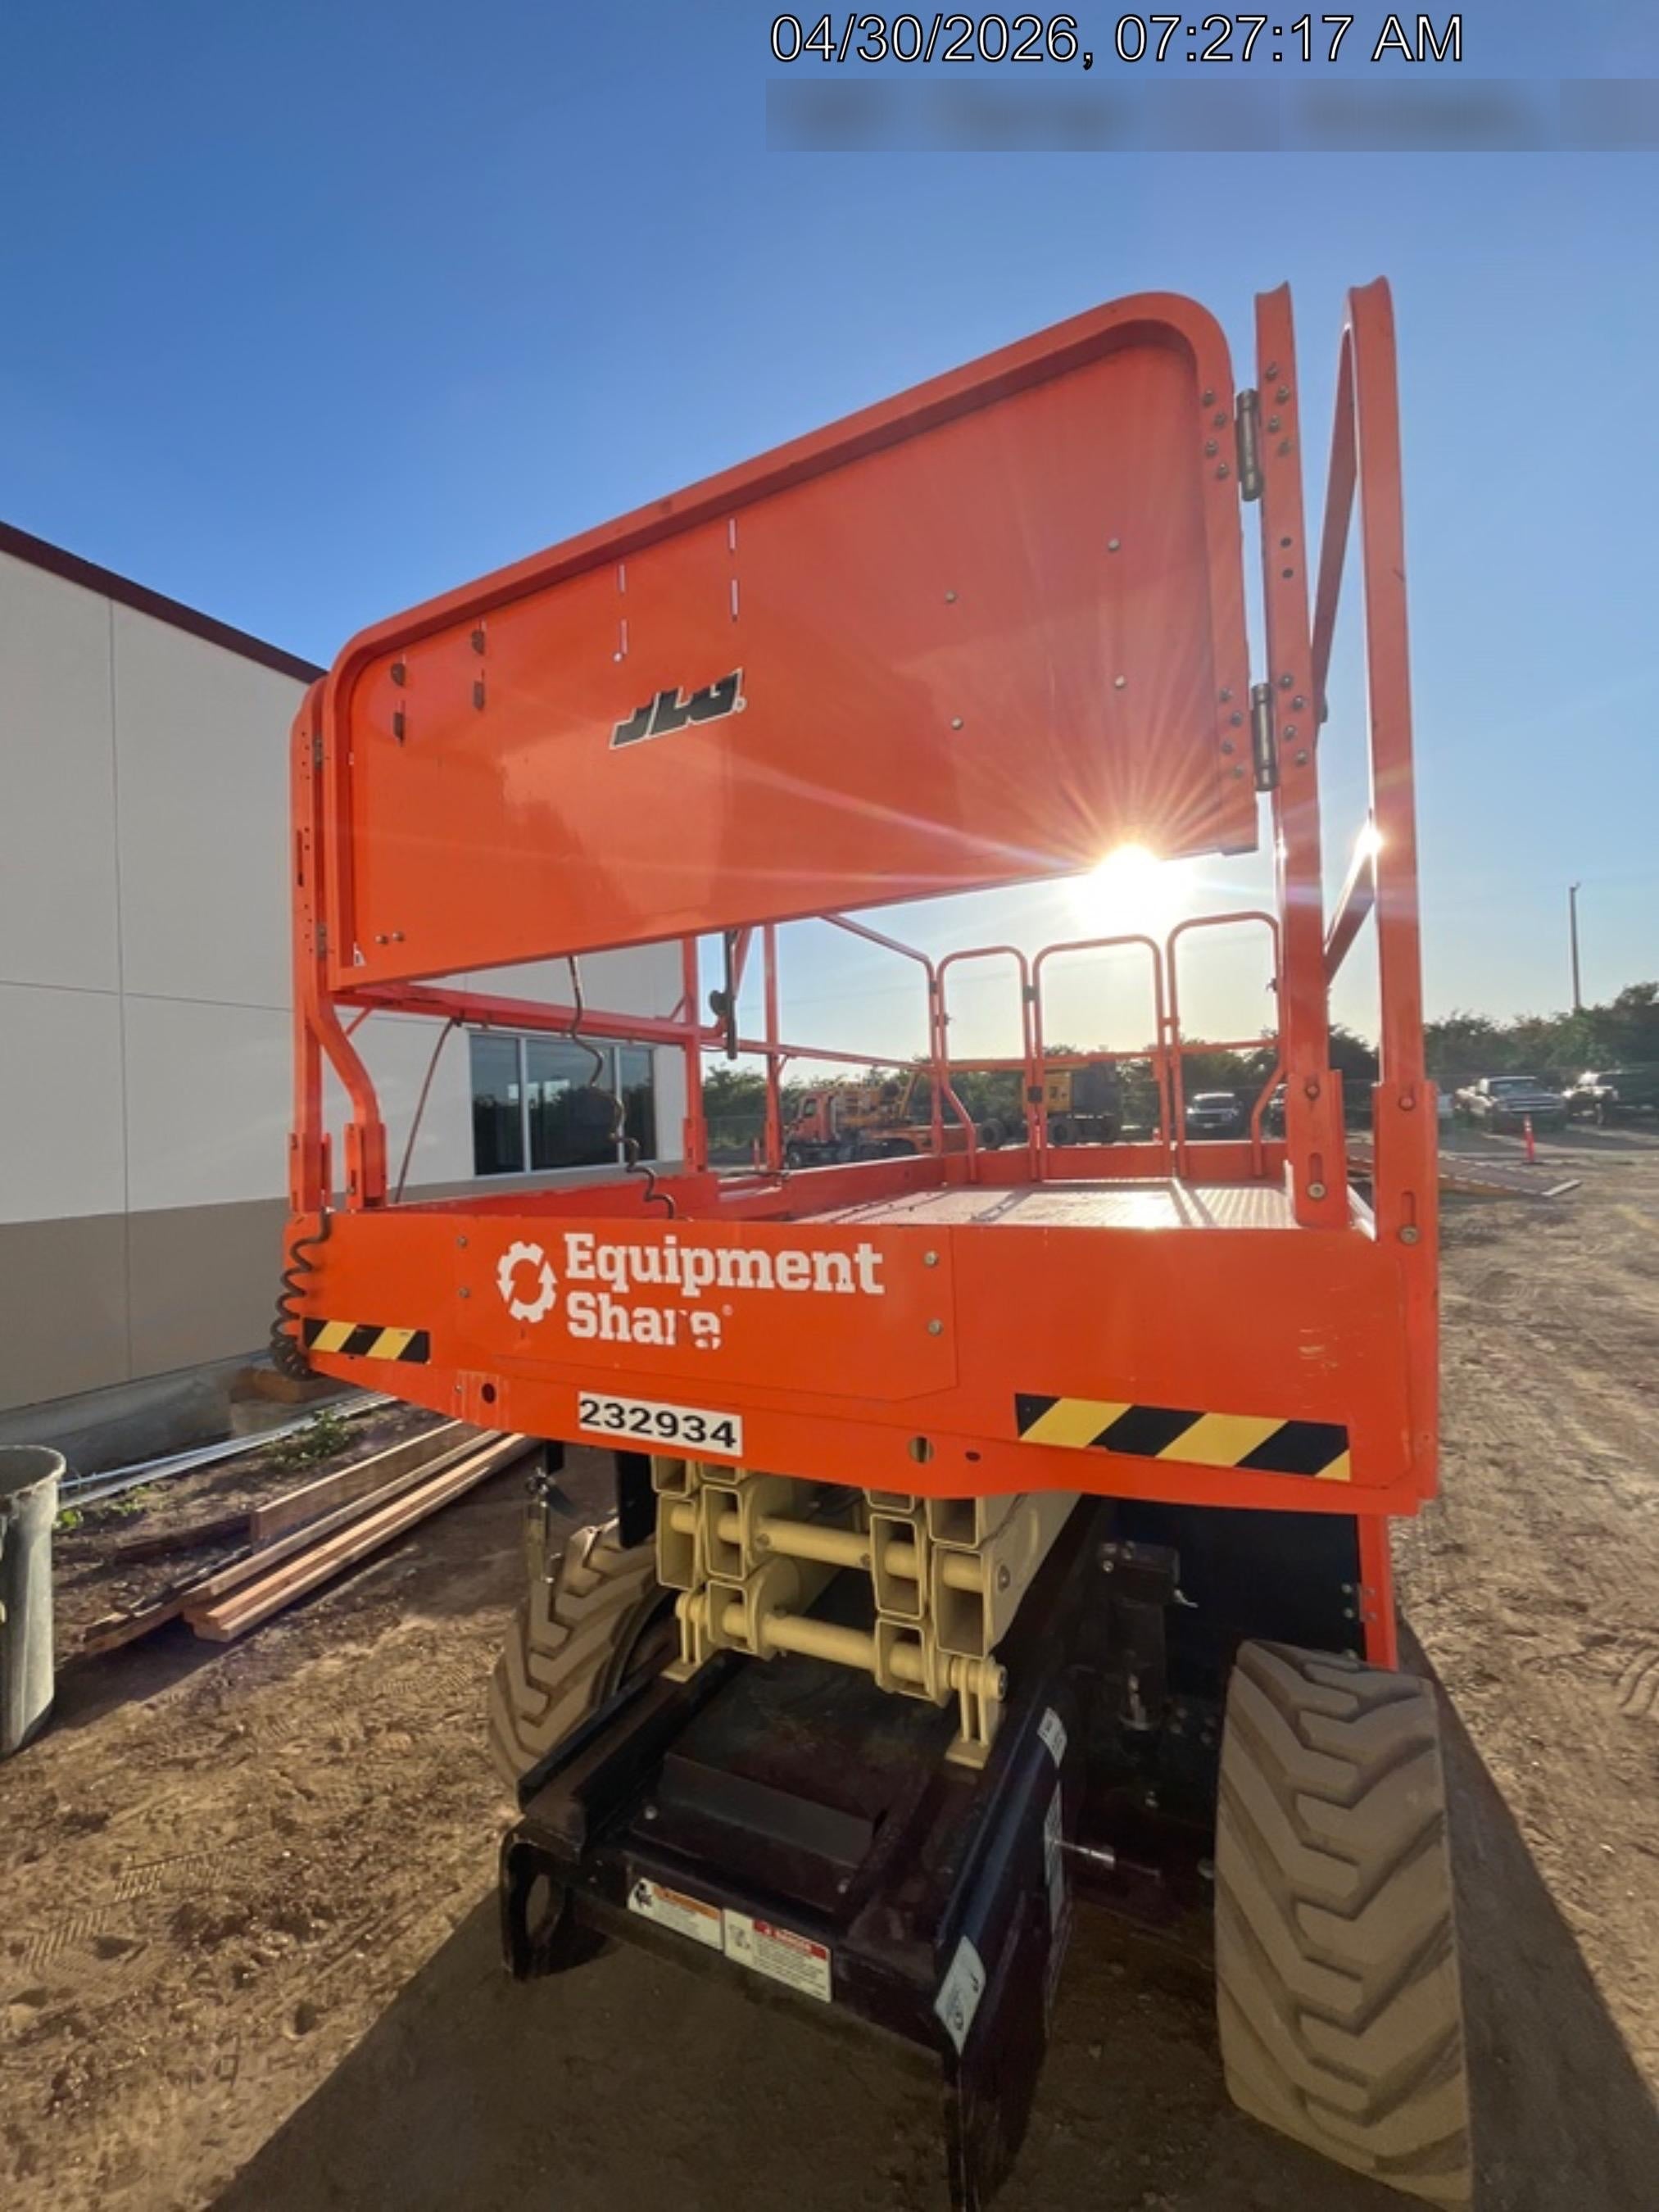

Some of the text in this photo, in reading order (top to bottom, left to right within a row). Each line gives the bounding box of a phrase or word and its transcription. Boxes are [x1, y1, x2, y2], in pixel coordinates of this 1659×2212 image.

[610, 667, 745, 750] JLG
[564, 1233, 886, 1298] Equipment
[579, 1398, 737, 1448] 232934
